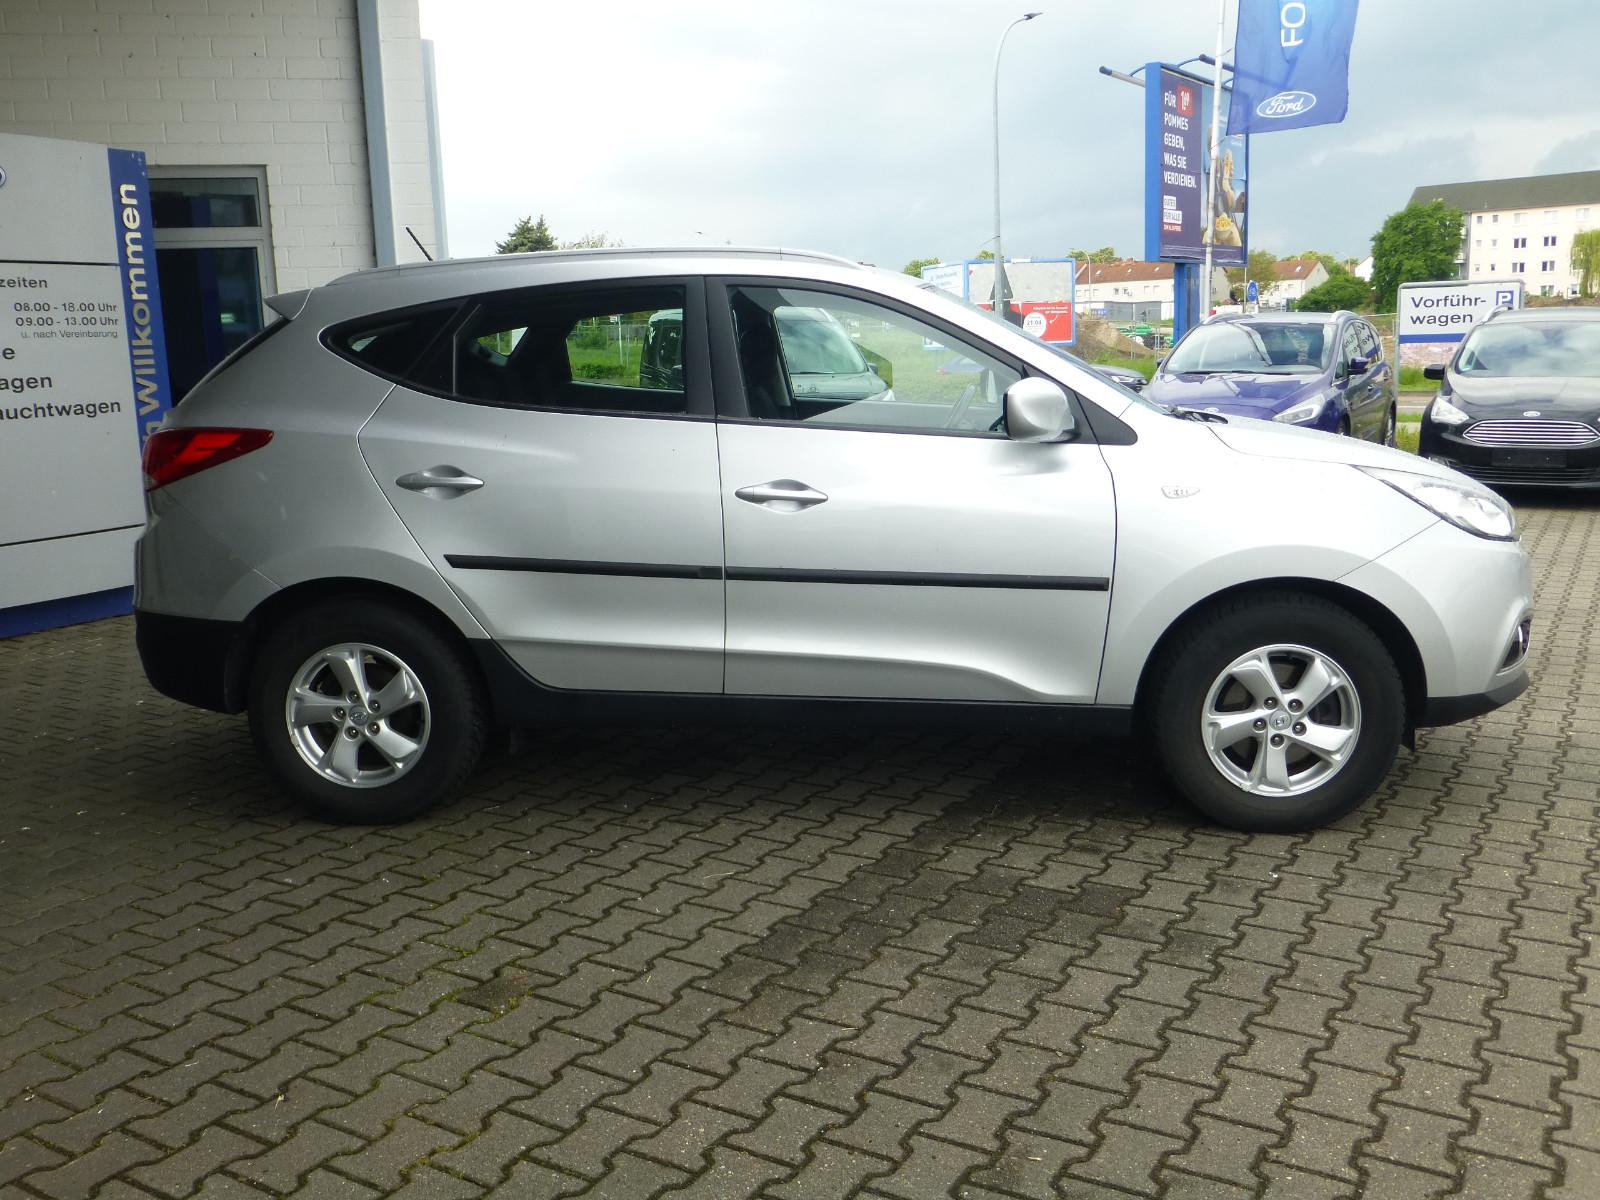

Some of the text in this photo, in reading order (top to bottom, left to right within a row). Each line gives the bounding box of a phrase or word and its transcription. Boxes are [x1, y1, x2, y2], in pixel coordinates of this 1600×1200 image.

[1164, 90, 1176, 108] FÜR
[1266, 95, 1304, 115] Ford
[1164, 112, 1189, 131] POMMES
[1164, 132, 1185, 151] GEBEN,
[1164, 151, 1187, 169] WAS SIE
[1164, 170, 1197, 189] VERDIENEN.
[14, 302, 51, 312] 08.00
[62, 302, 95, 312] 18.00
[98, 302, 117, 312] Uhr
[1411, 294, 1486, 308] Vorführ-
[16, 317, 54, 327] 09.00
[64, 316, 97, 326] 13.00
[100, 317, 119, 326] Uhr
[1410, 313, 1473, 327] wagen
[33, 330, 57, 339] nach
[59, 330, 118, 339] Vereinbarung
